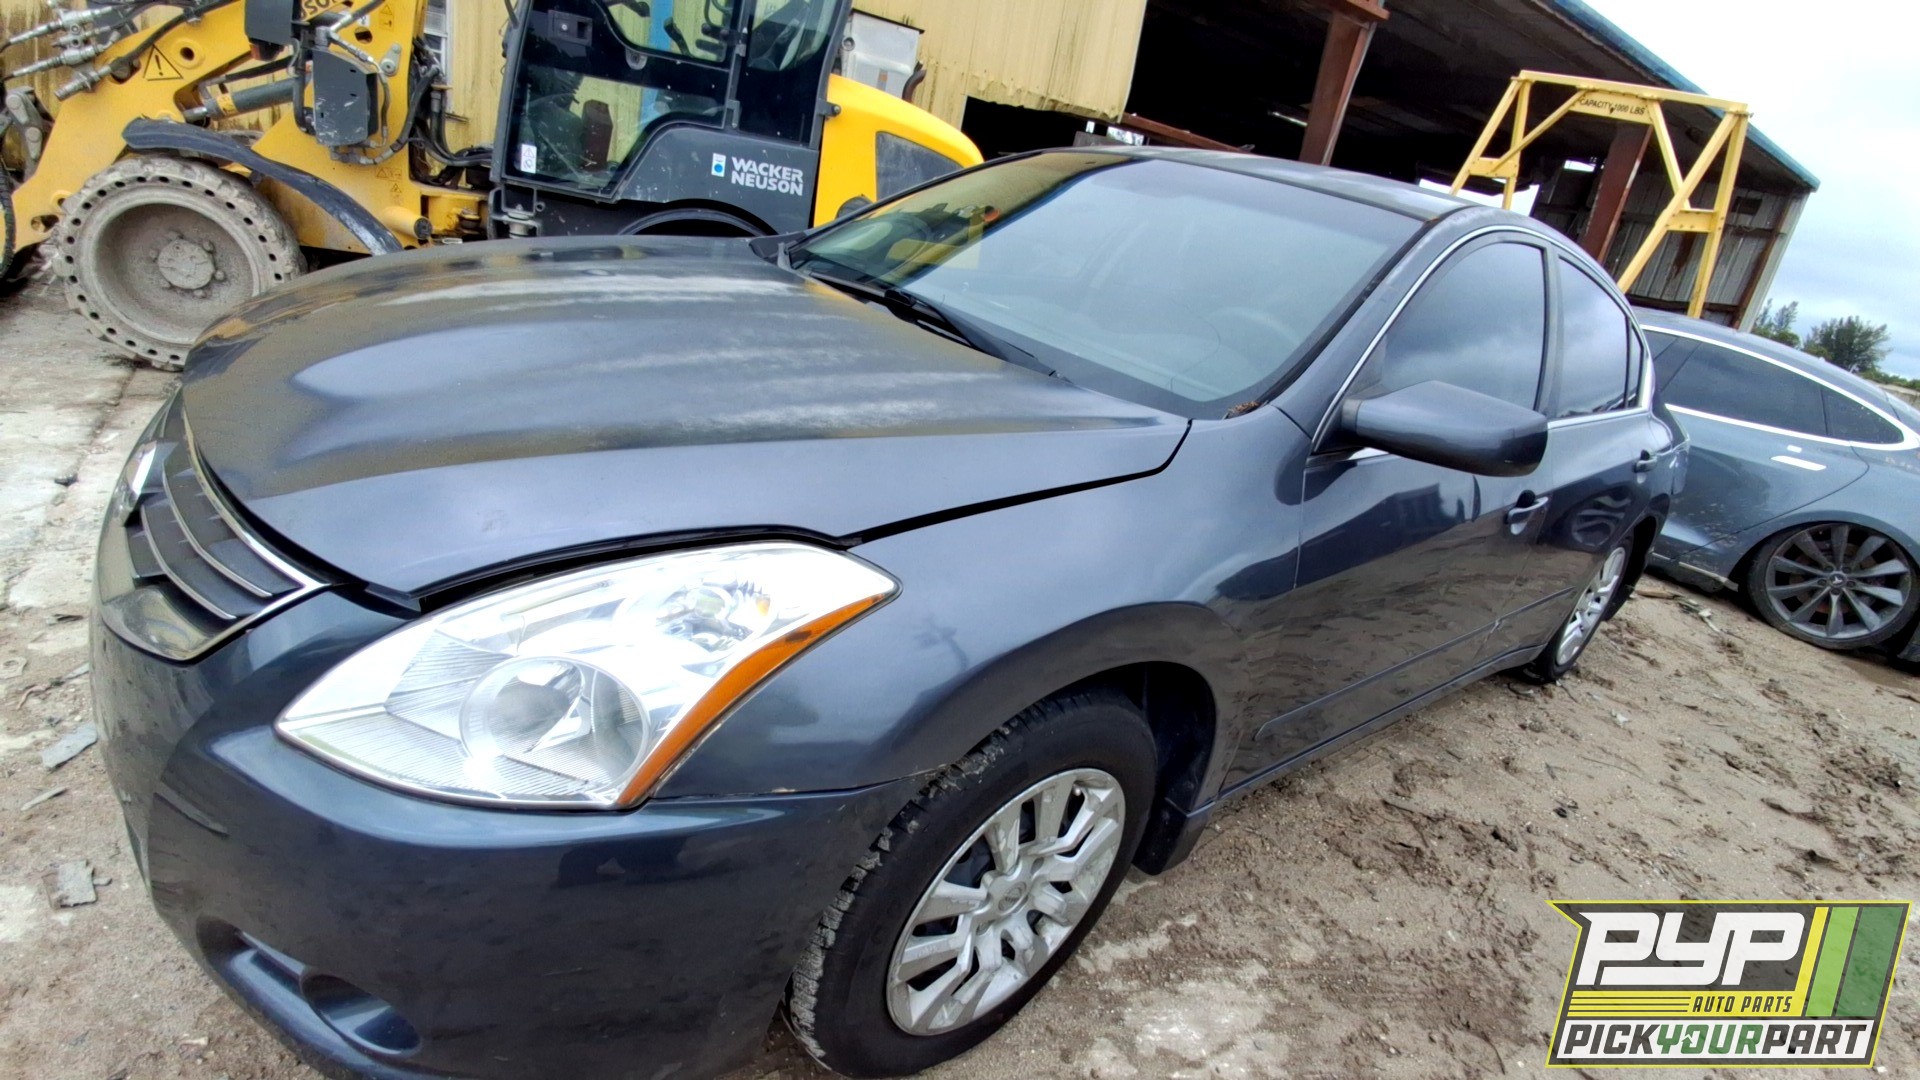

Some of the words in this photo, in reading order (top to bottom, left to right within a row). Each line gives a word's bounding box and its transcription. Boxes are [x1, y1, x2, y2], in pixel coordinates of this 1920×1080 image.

[1580, 98, 1612, 110] CAPACITY
[1614, 103, 1629, 113] 1000
[1630, 105, 1646, 116] LBS
[731, 156, 804, 183] WACKER
[731, 170, 804, 196] NEUSON
